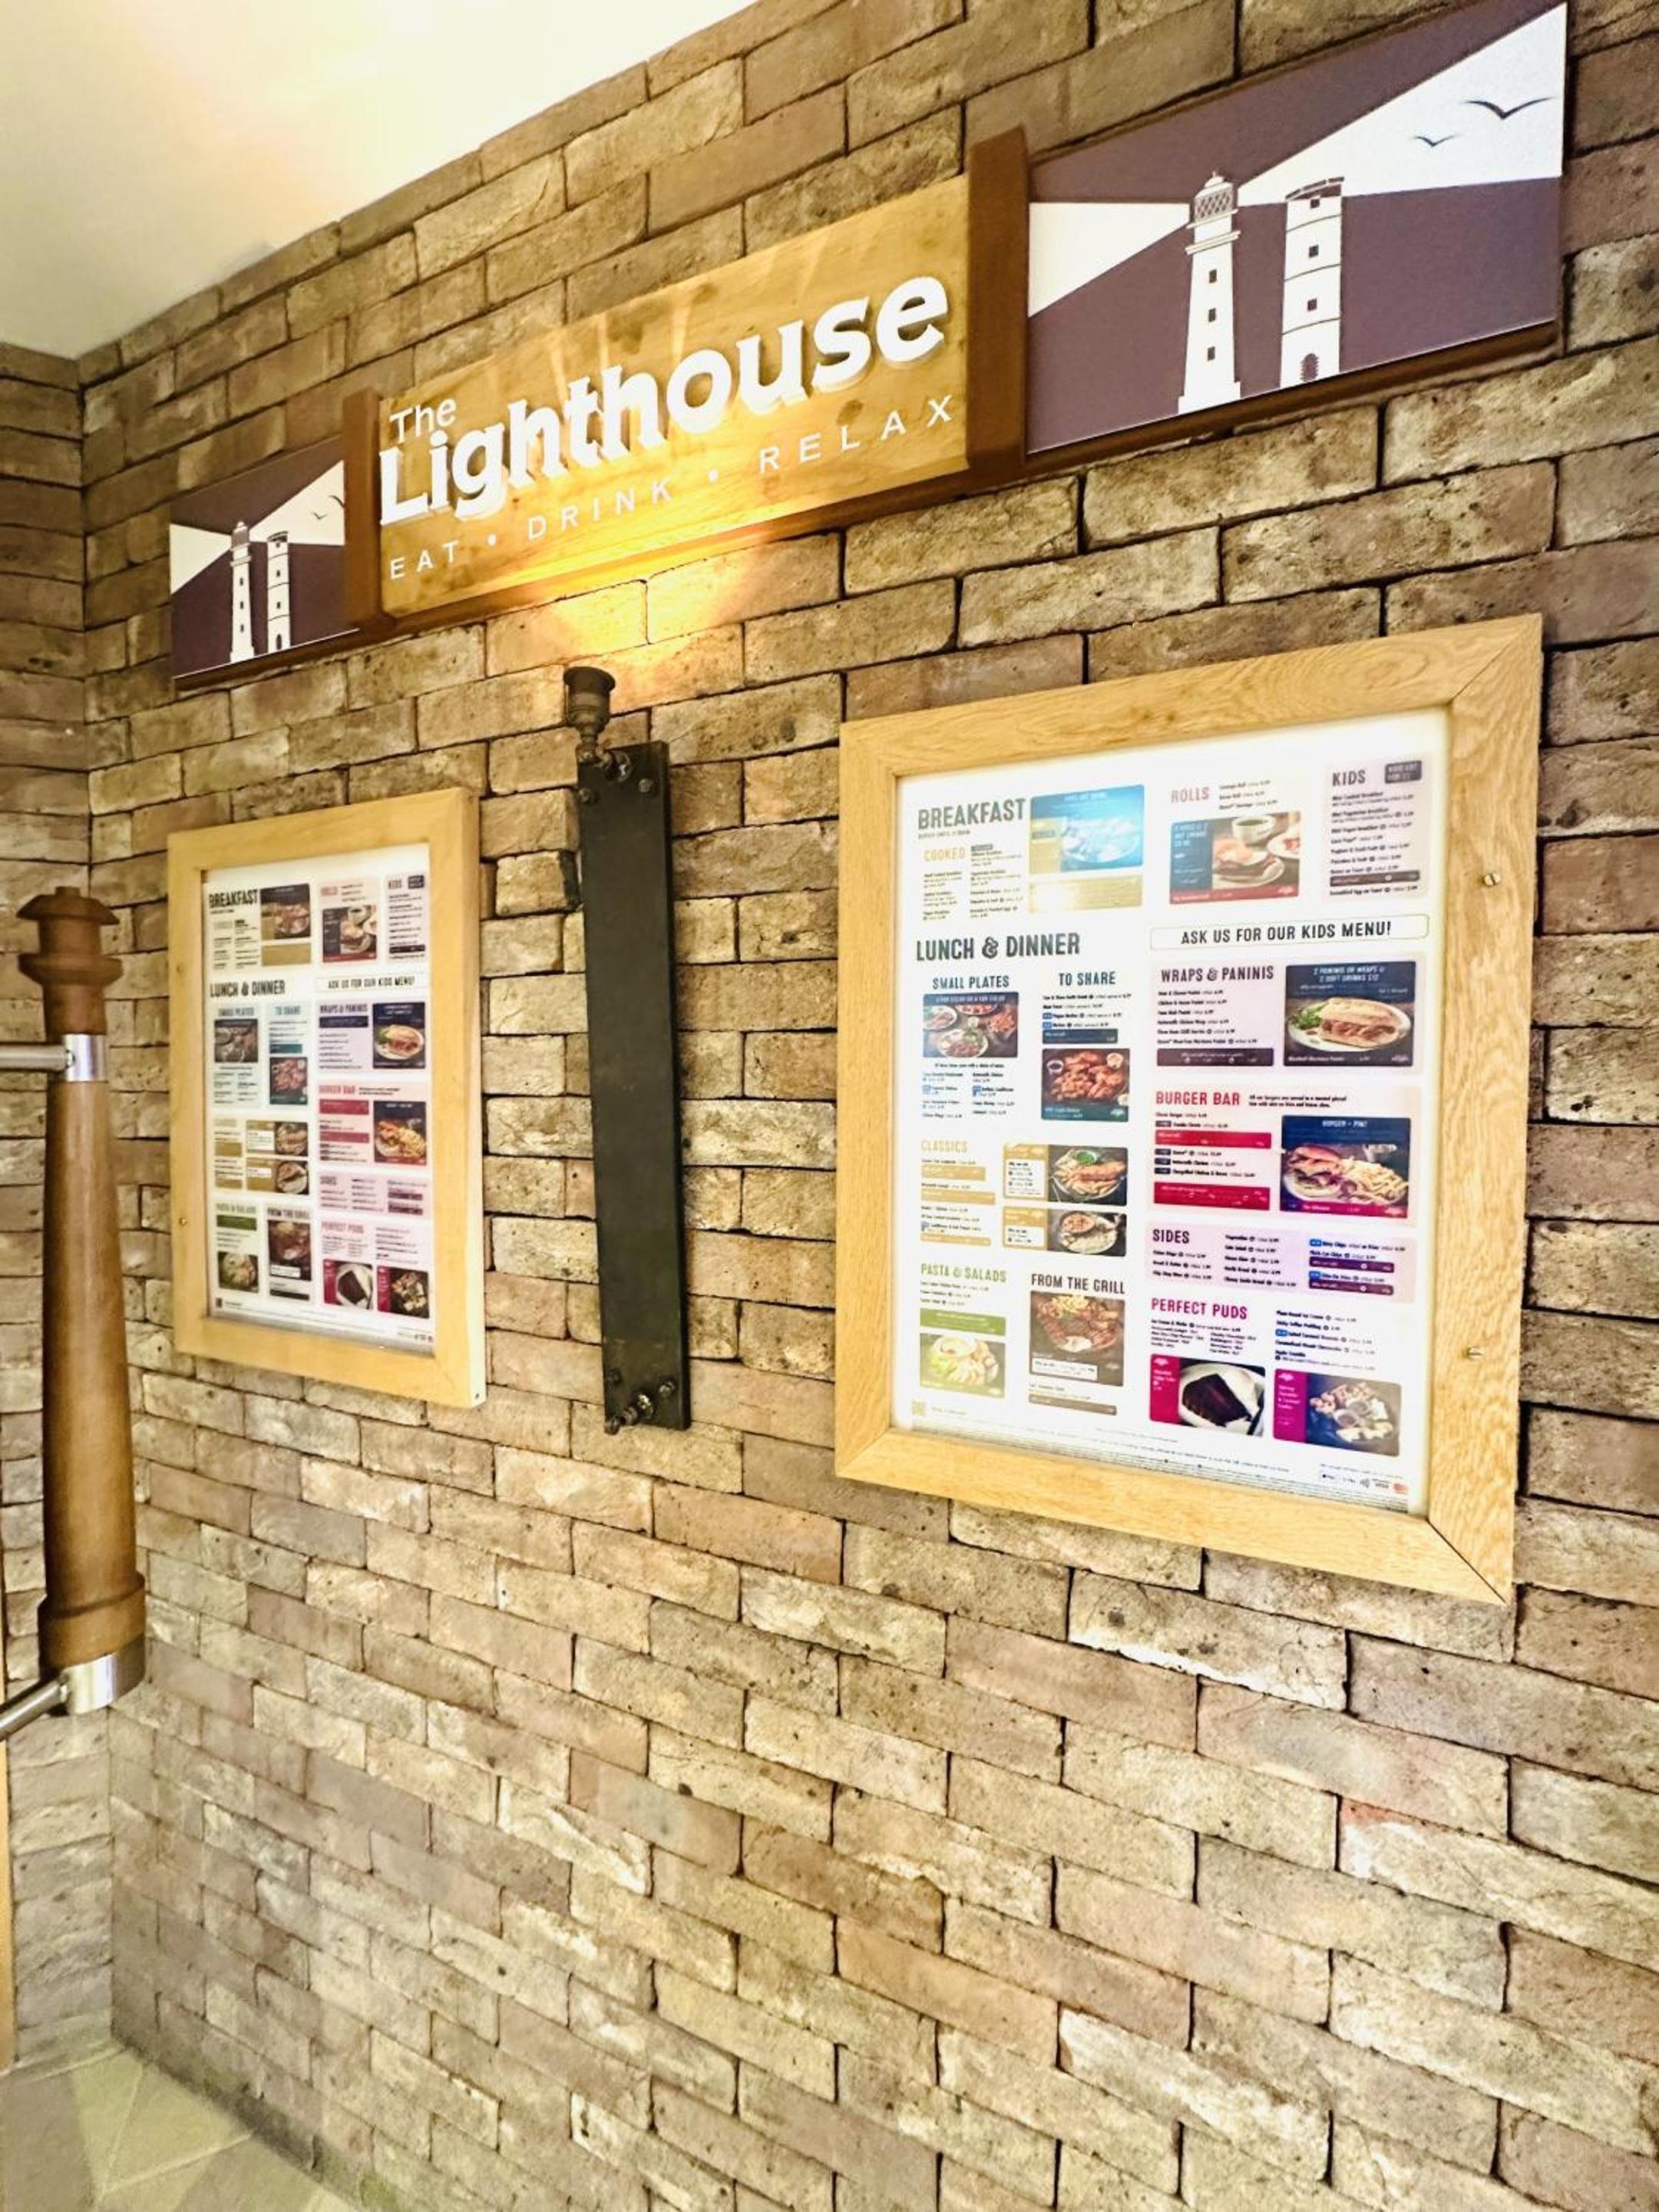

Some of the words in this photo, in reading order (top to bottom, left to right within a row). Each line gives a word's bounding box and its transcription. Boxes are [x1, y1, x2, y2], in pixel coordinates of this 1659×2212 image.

[379, 276, 948, 525] Lighthouse
[389, 398, 456, 444] The
[390, 541, 459, 579] EAT
[528, 478, 671, 541] DRINK
[758, 395, 953, 474] RELAX
[1332, 769, 1366, 786] KIDS
[1171, 787, 1210, 803] ROLLS
[917, 798, 1027, 830] BREAKFAST
[924, 846, 965, 862] COOKED
[209, 889, 259, 908] BREAKFAST
[1181, 931, 1208, 945] ASK
[1214, 928, 1231, 944] US
[1236, 927, 1261, 942] FOR
[1267, 926, 1295, 941] OUR
[1301, 924, 1336, 939] KIDS
[1342, 921, 1391, 937] MENU!
[917, 937, 974, 961] LUNCH
[982, 937, 999, 959] &
[1006, 932, 1080, 957] DINNER
[933, 976, 964, 990] SMALL
[969, 975, 1010, 989] PLATES
[1059, 972, 1072, 986] TO
[1077, 970, 1115, 985] SHARE
[1162, 967, 1203, 983] WRAPS
[1207, 967, 1218, 981] &
[1221, 965, 1274, 980] PANINIS
[210, 982, 239, 997] LUNCH
[252, 980, 285, 995] DINNER
[1155, 1091, 1208, 1106] BURGER
[1214, 1091, 1240, 1106] BAR
[920, 1140, 968, 1153] CLASSICS
[1152, 1228, 1190, 1244] SIDES
[920, 1264, 950, 1278] PASTA
[953, 1268, 961, 1278] &
[965, 1267, 1007, 1282] SALADS
[1031, 1274, 1063, 1288] FROM
[1067, 1276, 1089, 1291] THE
[1093, 1279, 1125, 1294] GRILL
[1152, 1298, 1206, 1315] PERFECT
[1212, 1303, 1248, 1319] PUDS
